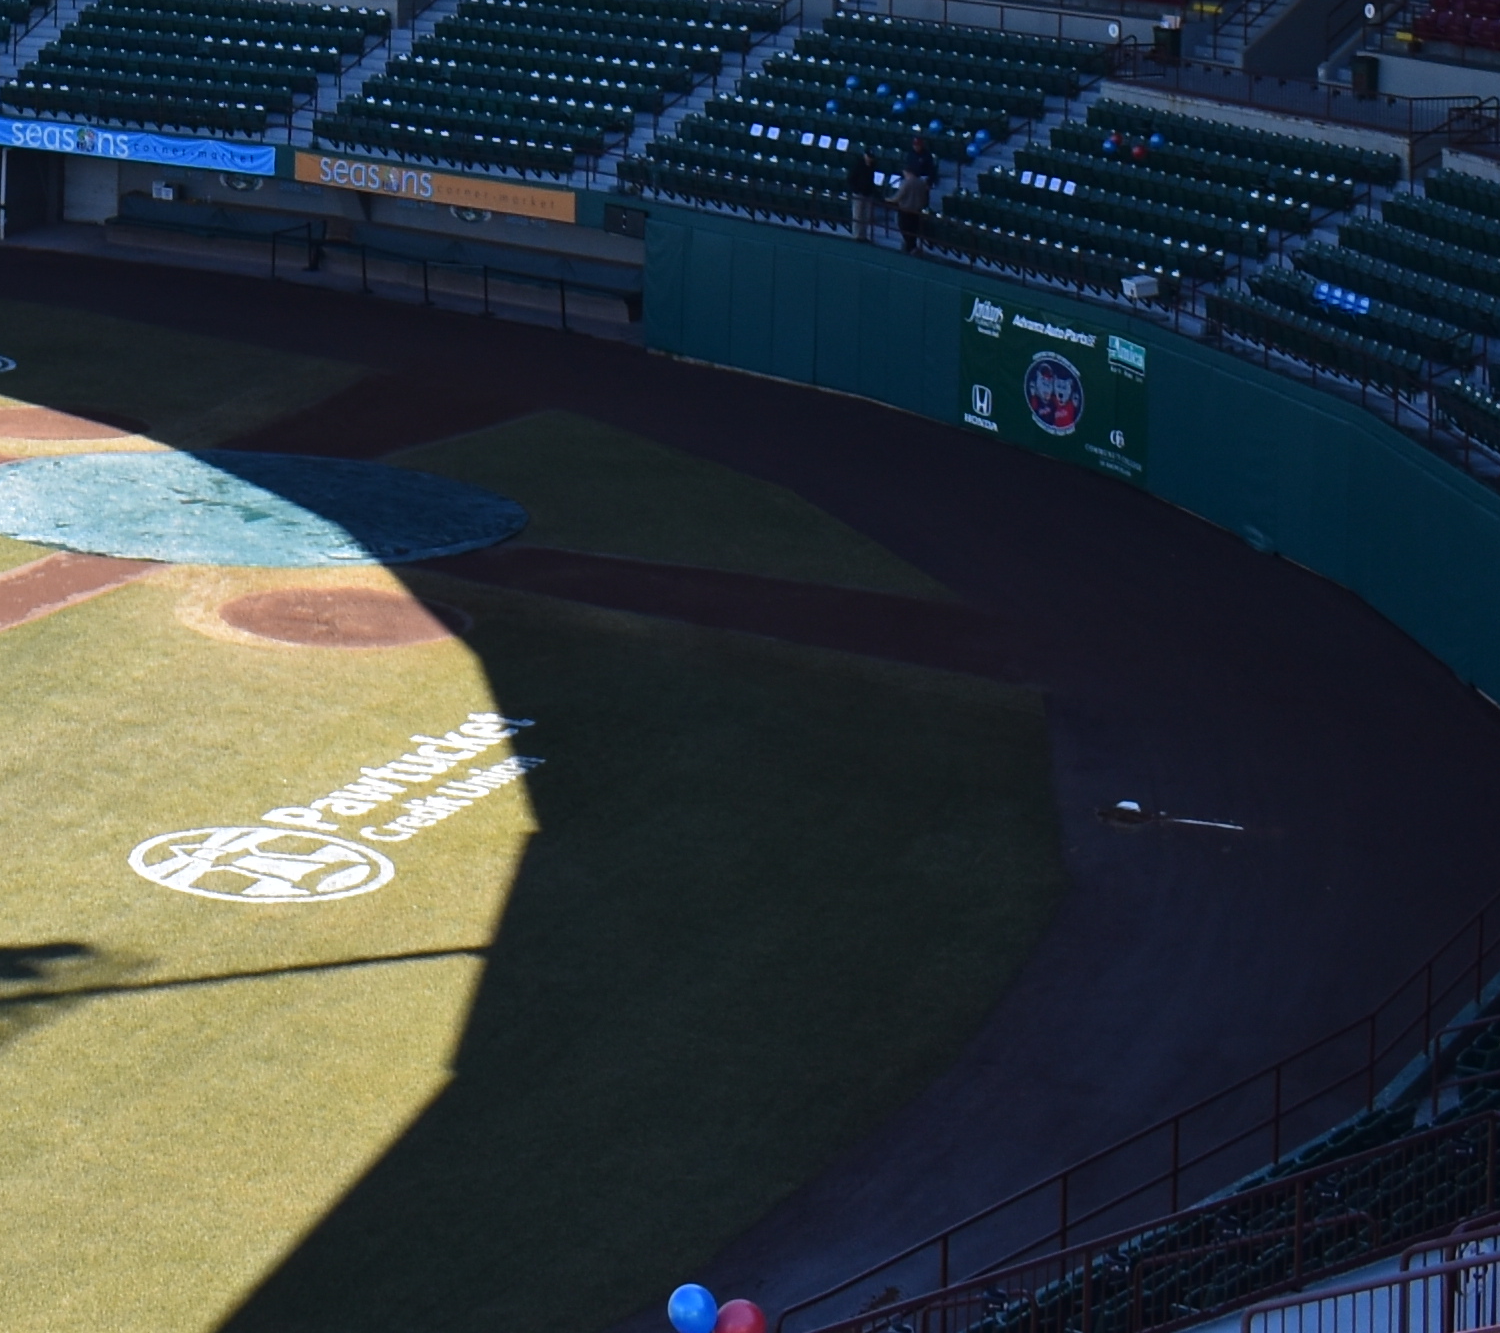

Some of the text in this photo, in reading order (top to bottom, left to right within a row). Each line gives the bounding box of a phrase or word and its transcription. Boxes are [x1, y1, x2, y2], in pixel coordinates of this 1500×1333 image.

[964, 412, 999, 433] HONDA
[262, 712, 536, 831] Pawtucket
[360, 755, 547, 843] Credit Union
